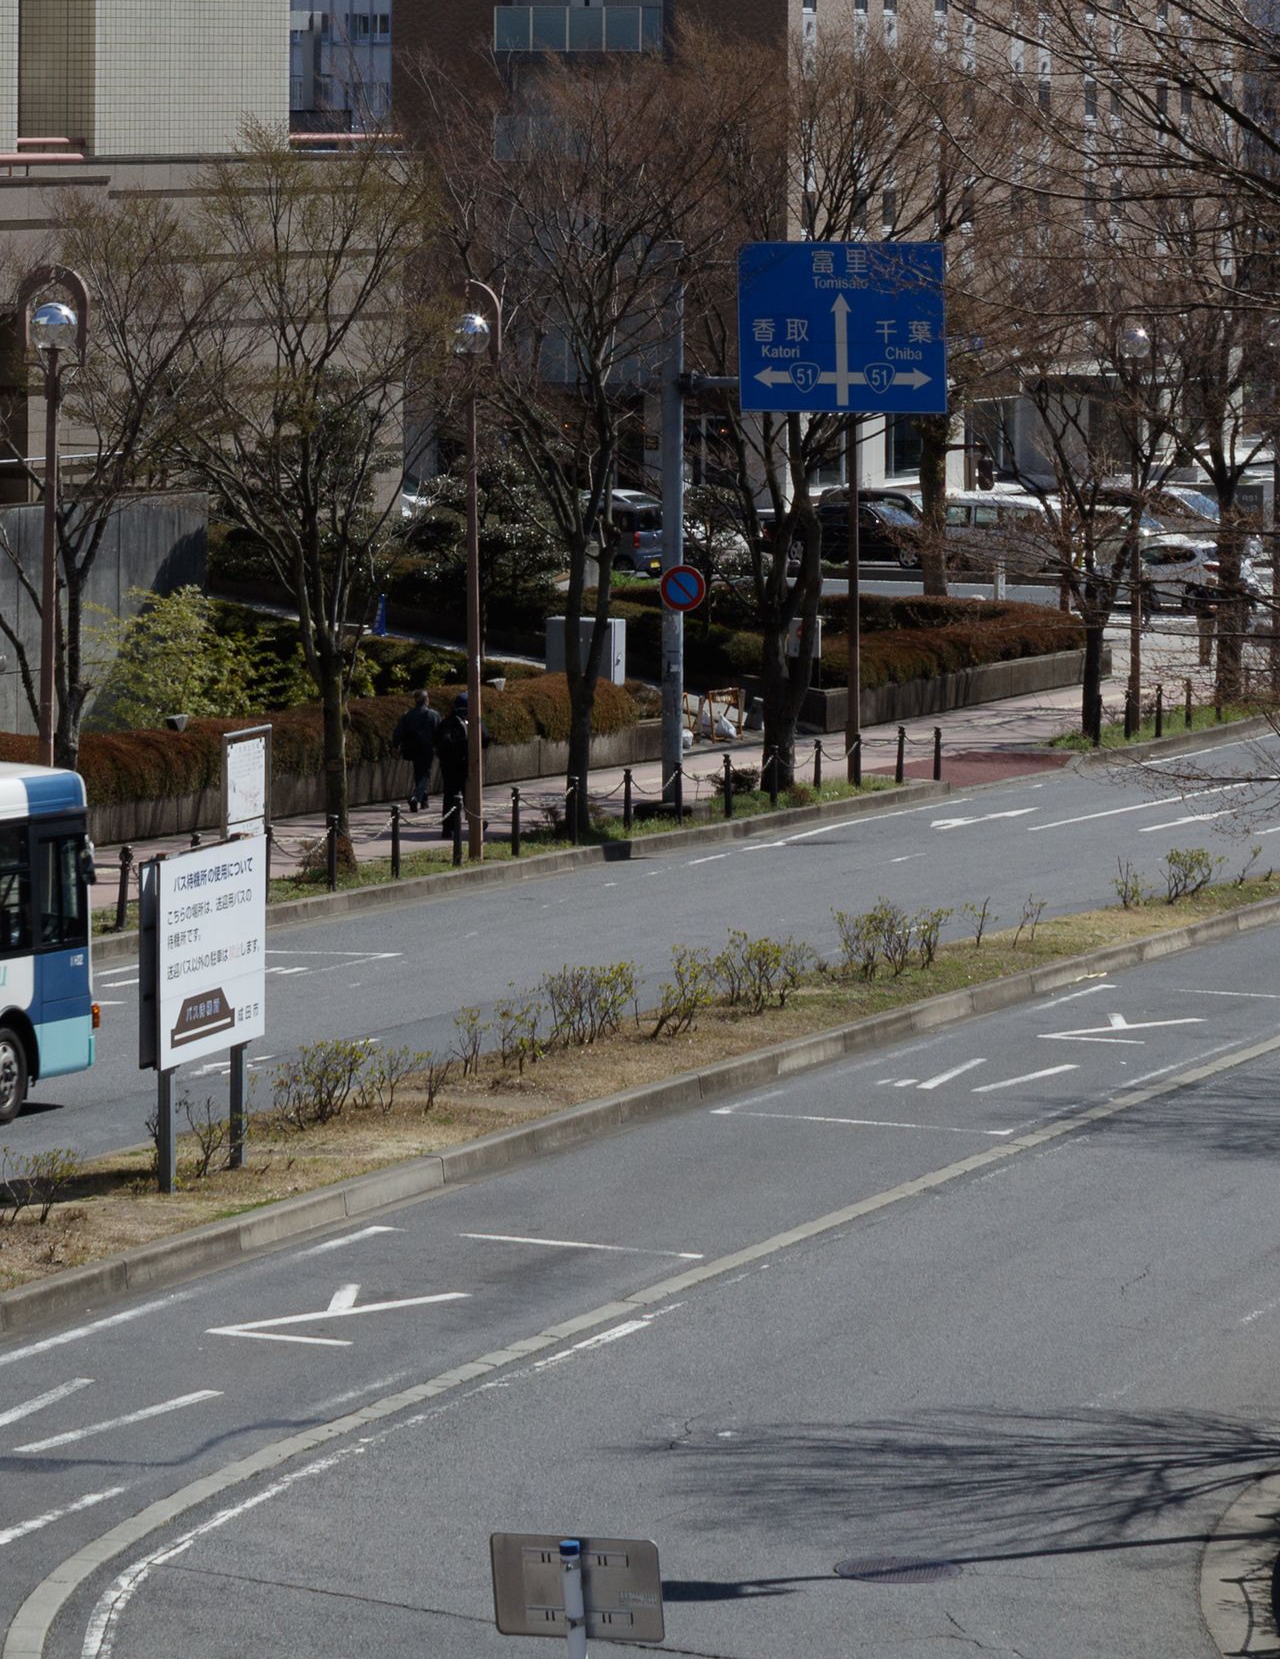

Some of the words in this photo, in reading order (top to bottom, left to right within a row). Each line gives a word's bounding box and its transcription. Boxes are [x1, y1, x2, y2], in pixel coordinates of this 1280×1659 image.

[811, 249, 869, 274] 富里
[811, 276, 869, 290] Tomisato
[752, 318, 809, 342] 香取
[875, 319, 933, 344] 千葉
[761, 345, 801, 359] Katori
[885, 346, 923, 361] Chiba
[796, 369, 813, 386] 51
[871, 369, 888, 386] 51
[173, 857, 253, 892] バス待機所の使用について
